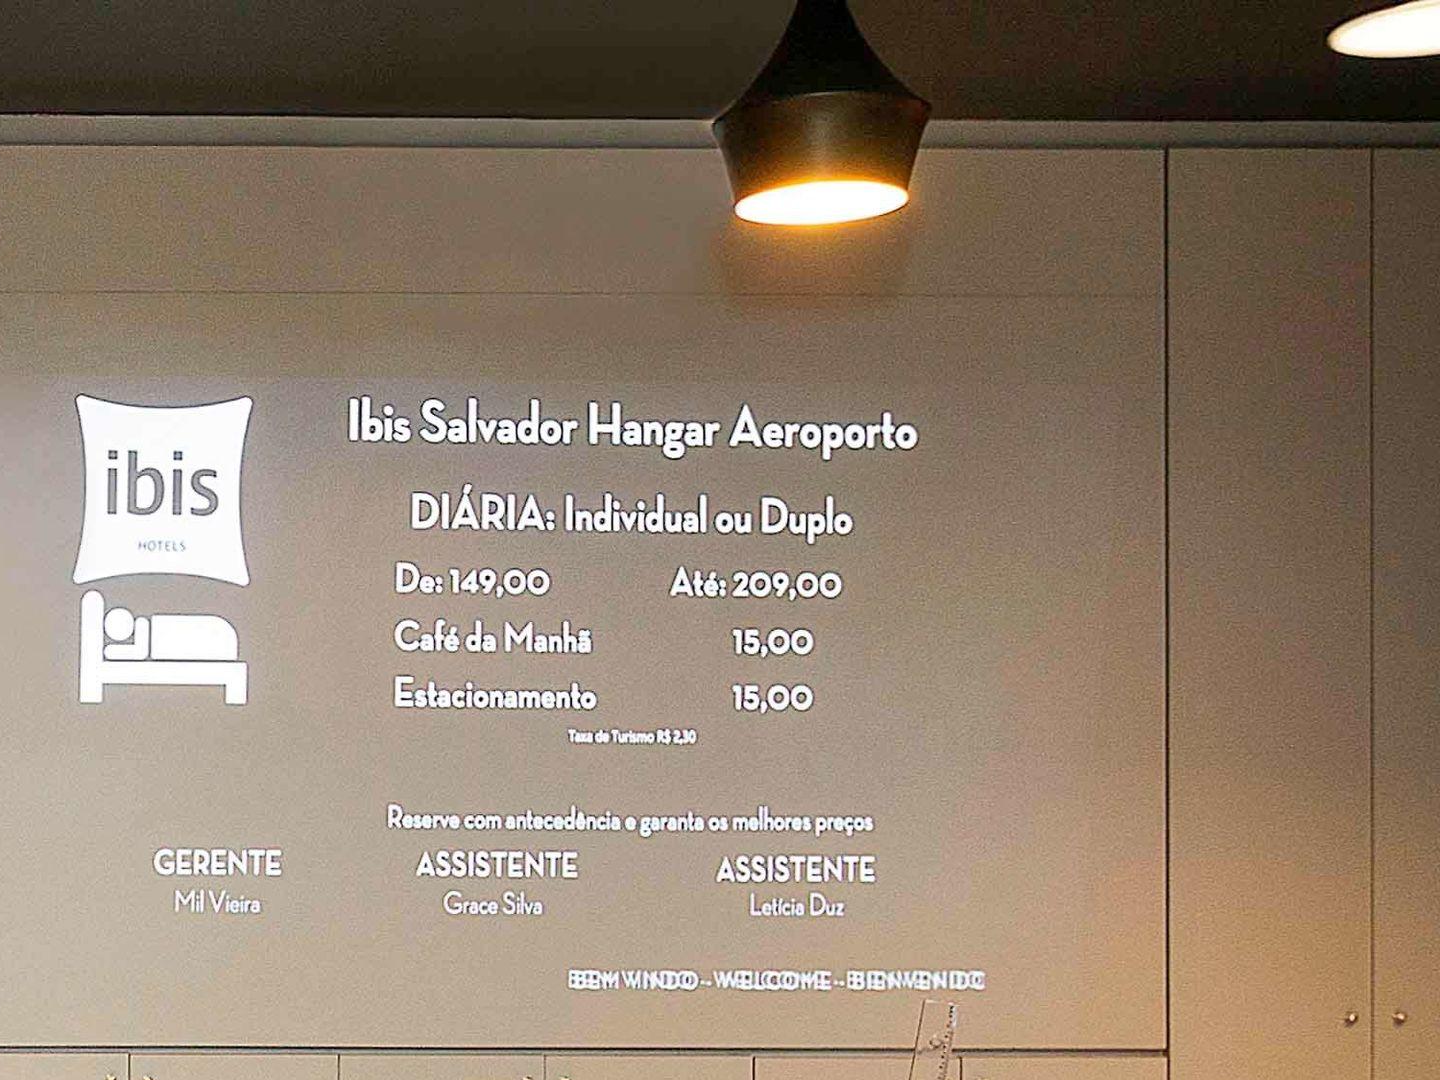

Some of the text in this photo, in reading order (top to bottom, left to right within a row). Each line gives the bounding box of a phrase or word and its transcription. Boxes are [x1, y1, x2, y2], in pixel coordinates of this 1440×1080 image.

[348, 395, 919, 461] Ibis Salvador Hangar Aeroporto
[107, 450, 219, 516] ibis
[411, 482, 854, 545] DIÁRIA: Individual ou Duplo
[137, 540, 186, 552] HOTELS
[395, 562, 551, 598] De: 149,00
[669, 566, 843, 601] Até: 209,00
[393, 619, 593, 654] Café da Manhã
[732, 628, 814, 658] 15,00
[394, 675, 598, 711] Estacionamento
[732, 684, 814, 714] 15,00
[567, 729, 593, 743] Taxa
[594, 729, 610, 744] de
[611, 729, 655, 744] Turismo
[387, 804, 875, 838] Reserve com antecedência e garanta os melhores preços
[153, 848, 283, 876] GERENTE
[415, 851, 579, 879] ASSISTENTE
[716, 856, 877, 883] ASSISTENTE
[174, 889, 262, 913] Mil Vieira
[443, 890, 544, 915] Grace Silva
[750, 892, 846, 916] Letícia Duz
